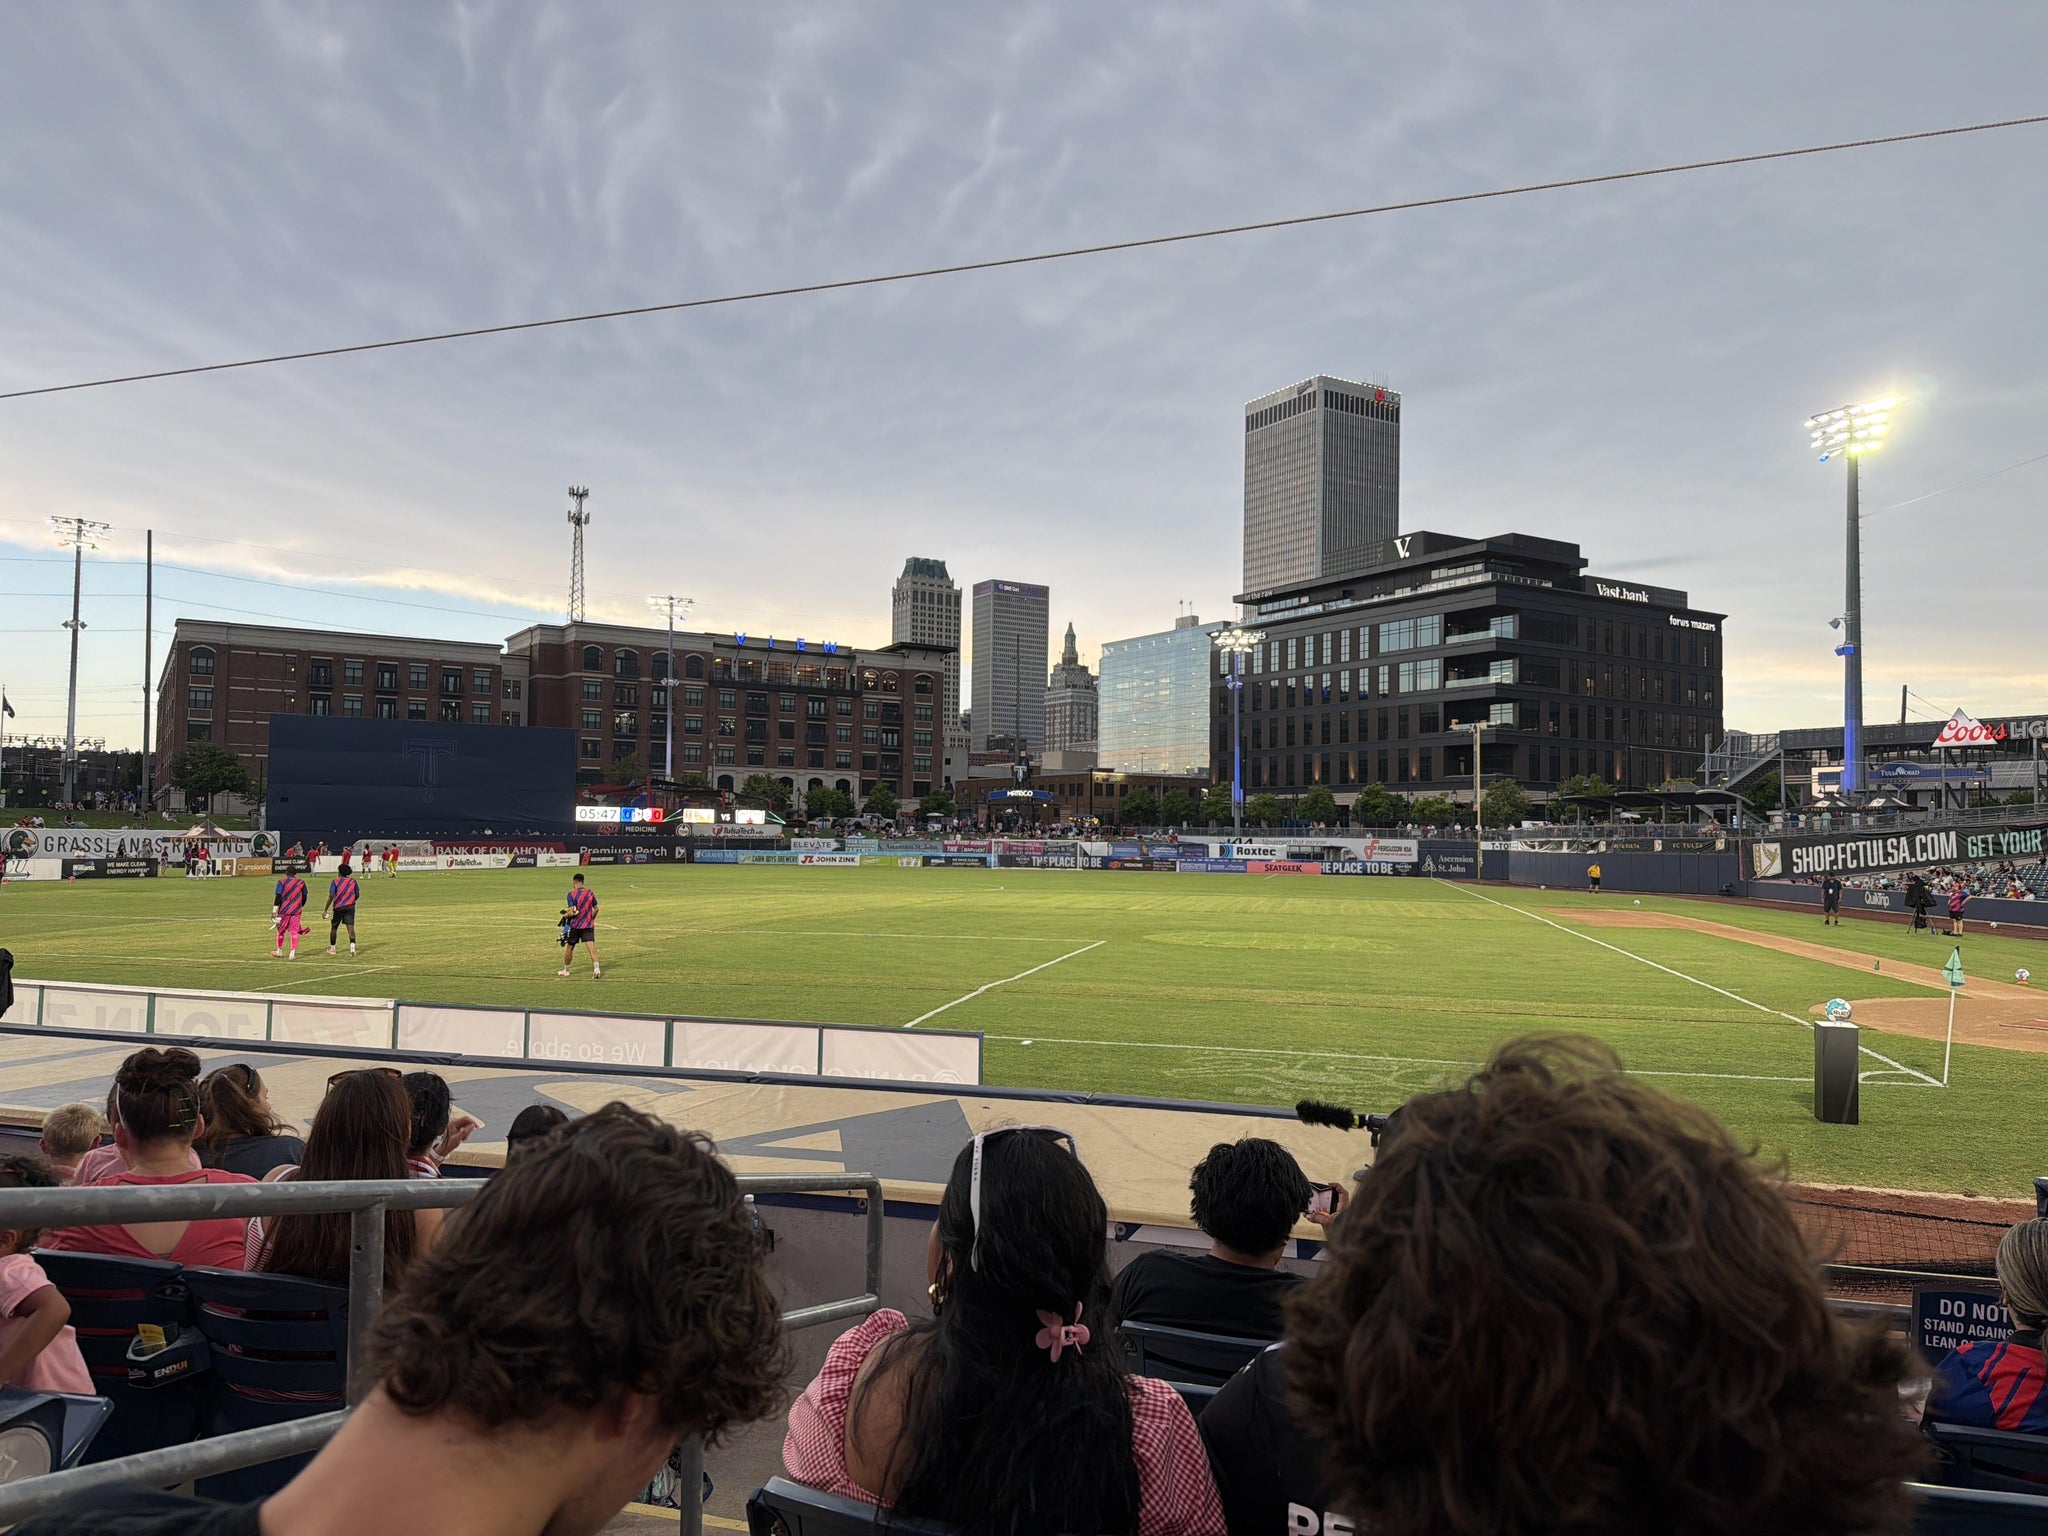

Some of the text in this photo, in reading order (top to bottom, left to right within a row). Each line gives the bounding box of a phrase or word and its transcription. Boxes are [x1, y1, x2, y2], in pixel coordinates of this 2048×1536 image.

[1938, 718, 2008, 742] Coors
[579, 809, 617, 819] 05:47
[625, 825, 657, 833] MEDICINE
[580, 845, 632, 854] Premium
[793, 841, 832, 849] ELEVATE
[436, 846, 556, 855] BANK OF OKLAHOMA
[1236, 846, 1277, 856] Roxtec
[1792, 829, 2043, 873] SHOP.FCTULSA.COM GET YOUR
[1049, 856, 1076, 867] PLACE
[1091, 857, 1102, 868] BE
[1438, 854, 1474, 863] Ascension
[1264, 863, 1303, 873] SEATGEEK
[1332, 862, 1363, 874] PLACE
[1365, 863, 1379, 874] TO
[1380, 863, 1394, 875] BE
[1449, 865, 1466, 873] John
[1939, 1298, 2011, 1324] DO NOT
[1924, 1317, 2019, 1341] STAND AGAINS
[1925, 1334, 1957, 1350] LEAN
